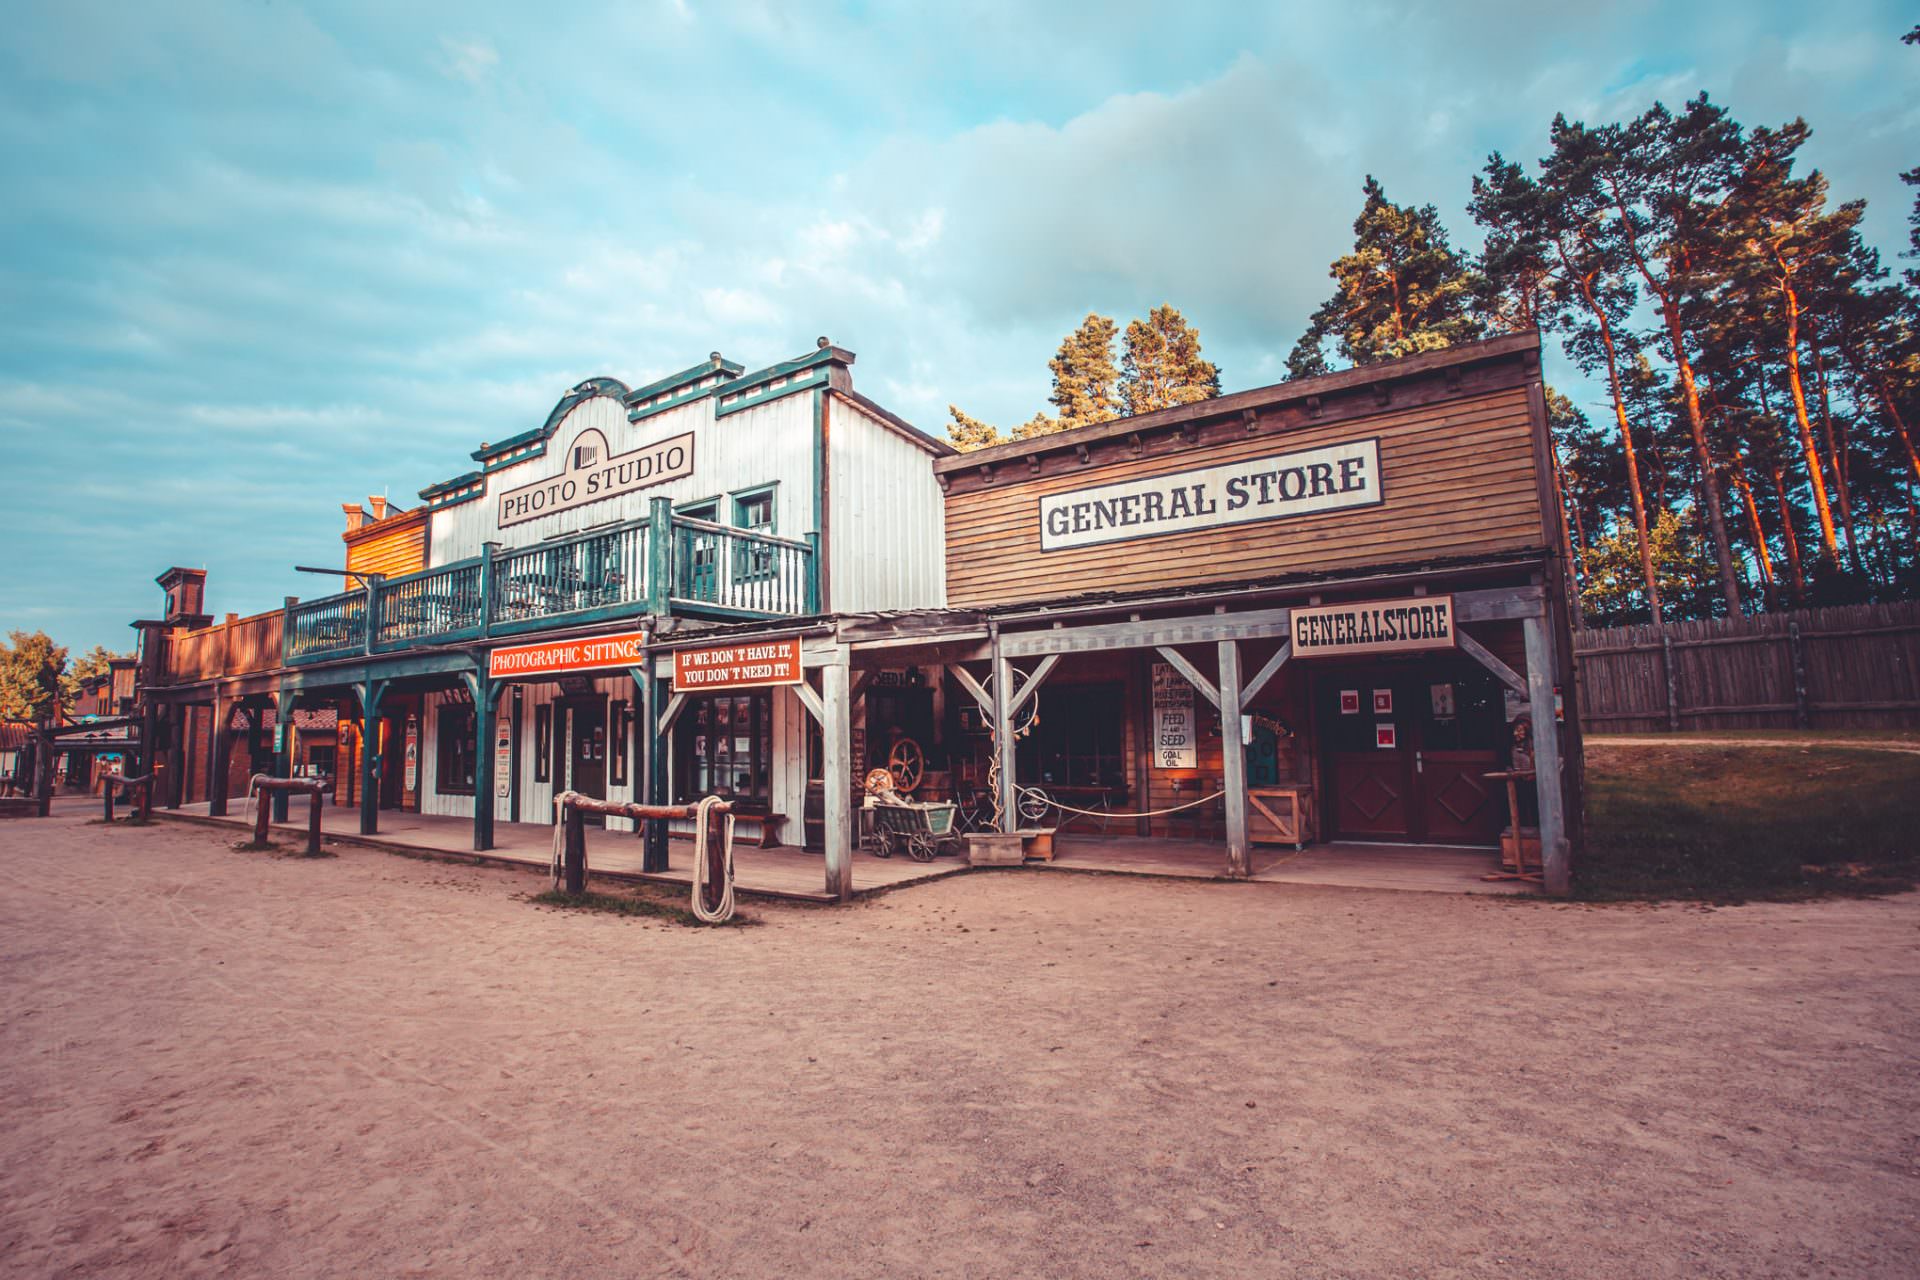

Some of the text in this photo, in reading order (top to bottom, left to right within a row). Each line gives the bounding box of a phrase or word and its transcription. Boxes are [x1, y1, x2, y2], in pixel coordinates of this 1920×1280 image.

[504, 446, 685, 519] PHOTO STUDIO
[1046, 456, 1366, 537] GENERAL STORE
[1296, 604, 1448, 647] GENERALSTORE
[493, 639, 643, 671] PHOTOGRAPHIC SITTINGS
[682, 654, 691, 667] IF
[693, 652, 710, 666] WE
[747, 645, 776, 661] HAVE
[778, 644, 793, 659] IT,
[685, 670, 705, 683] YOU
[742, 664, 772, 679] NEED
[774, 663, 790, 677] IT!
[1162, 713, 1185, 726] FEED
[1160, 734, 1186, 746] SEED
